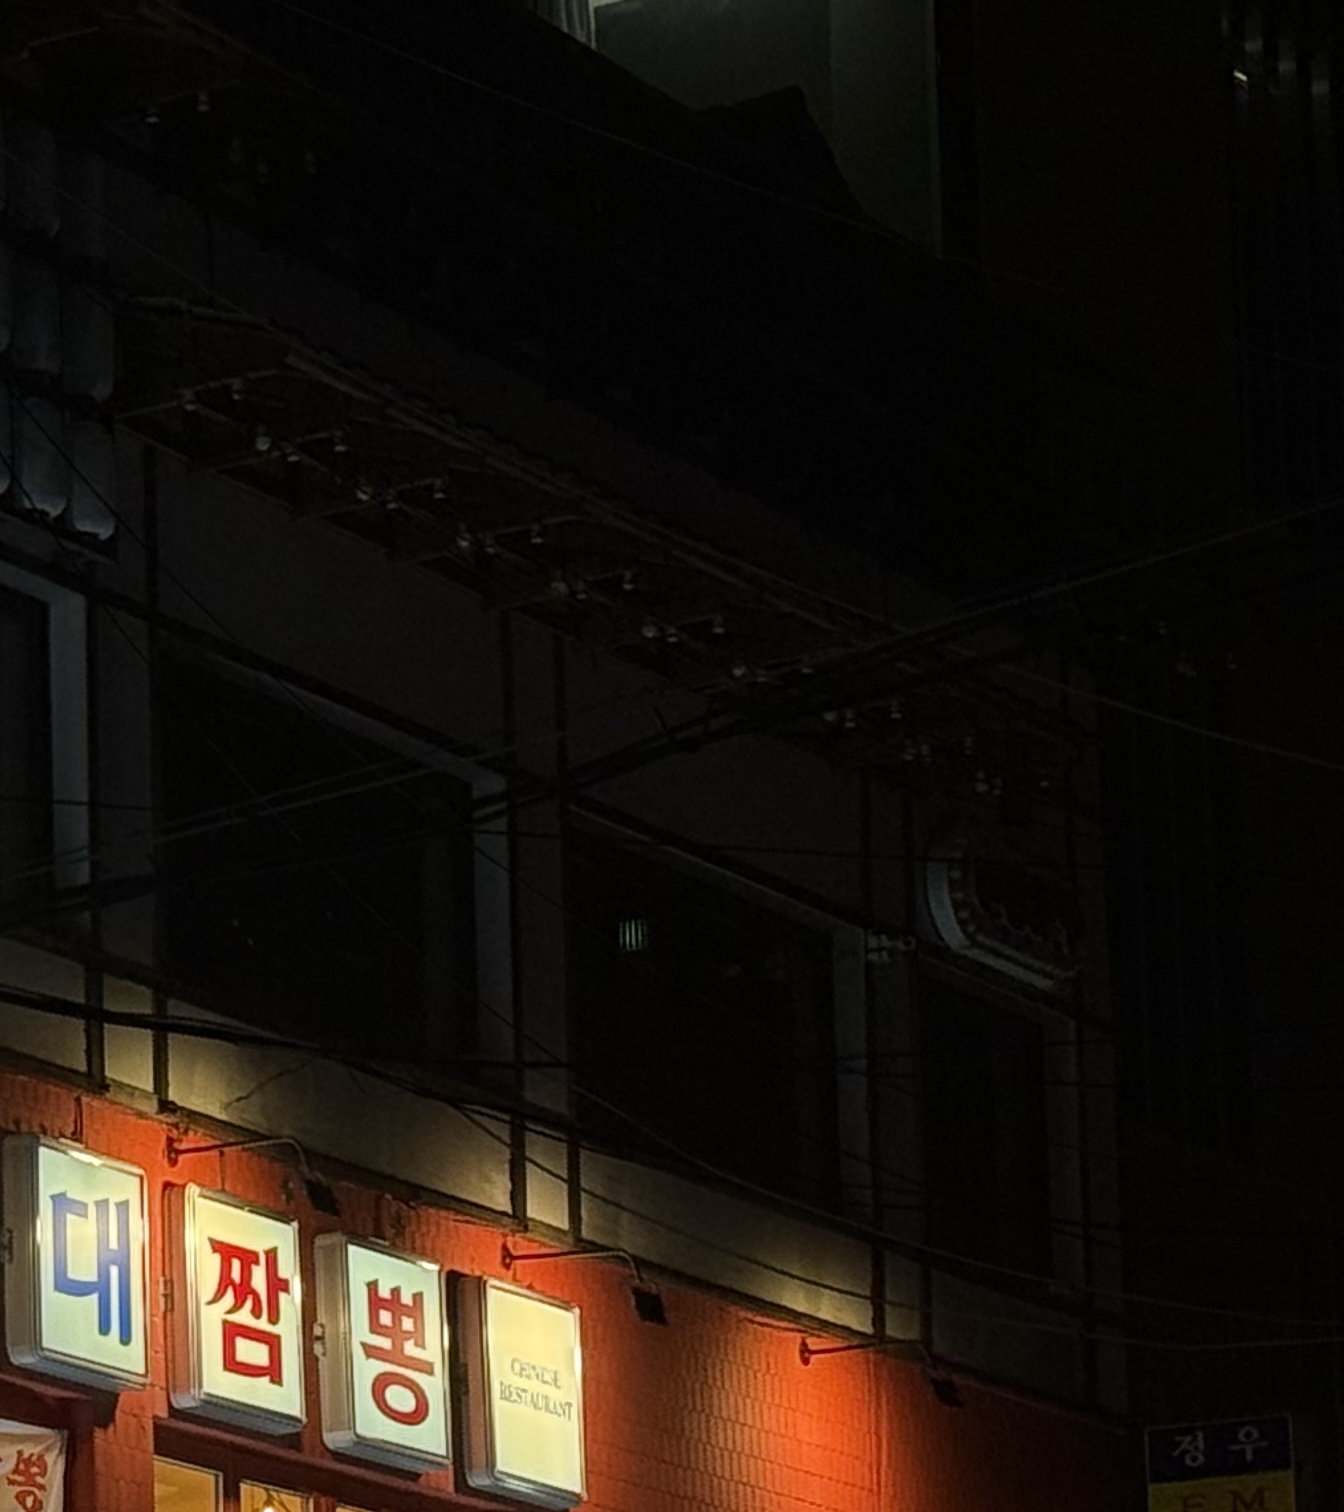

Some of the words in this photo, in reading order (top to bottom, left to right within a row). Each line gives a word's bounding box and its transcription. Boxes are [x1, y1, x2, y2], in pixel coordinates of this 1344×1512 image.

[510, 1357, 562, 1390] CHINESE
[499, 1380, 573, 1424] RESTAURANT
[1172, 1424, 1271, 1470] 정우
